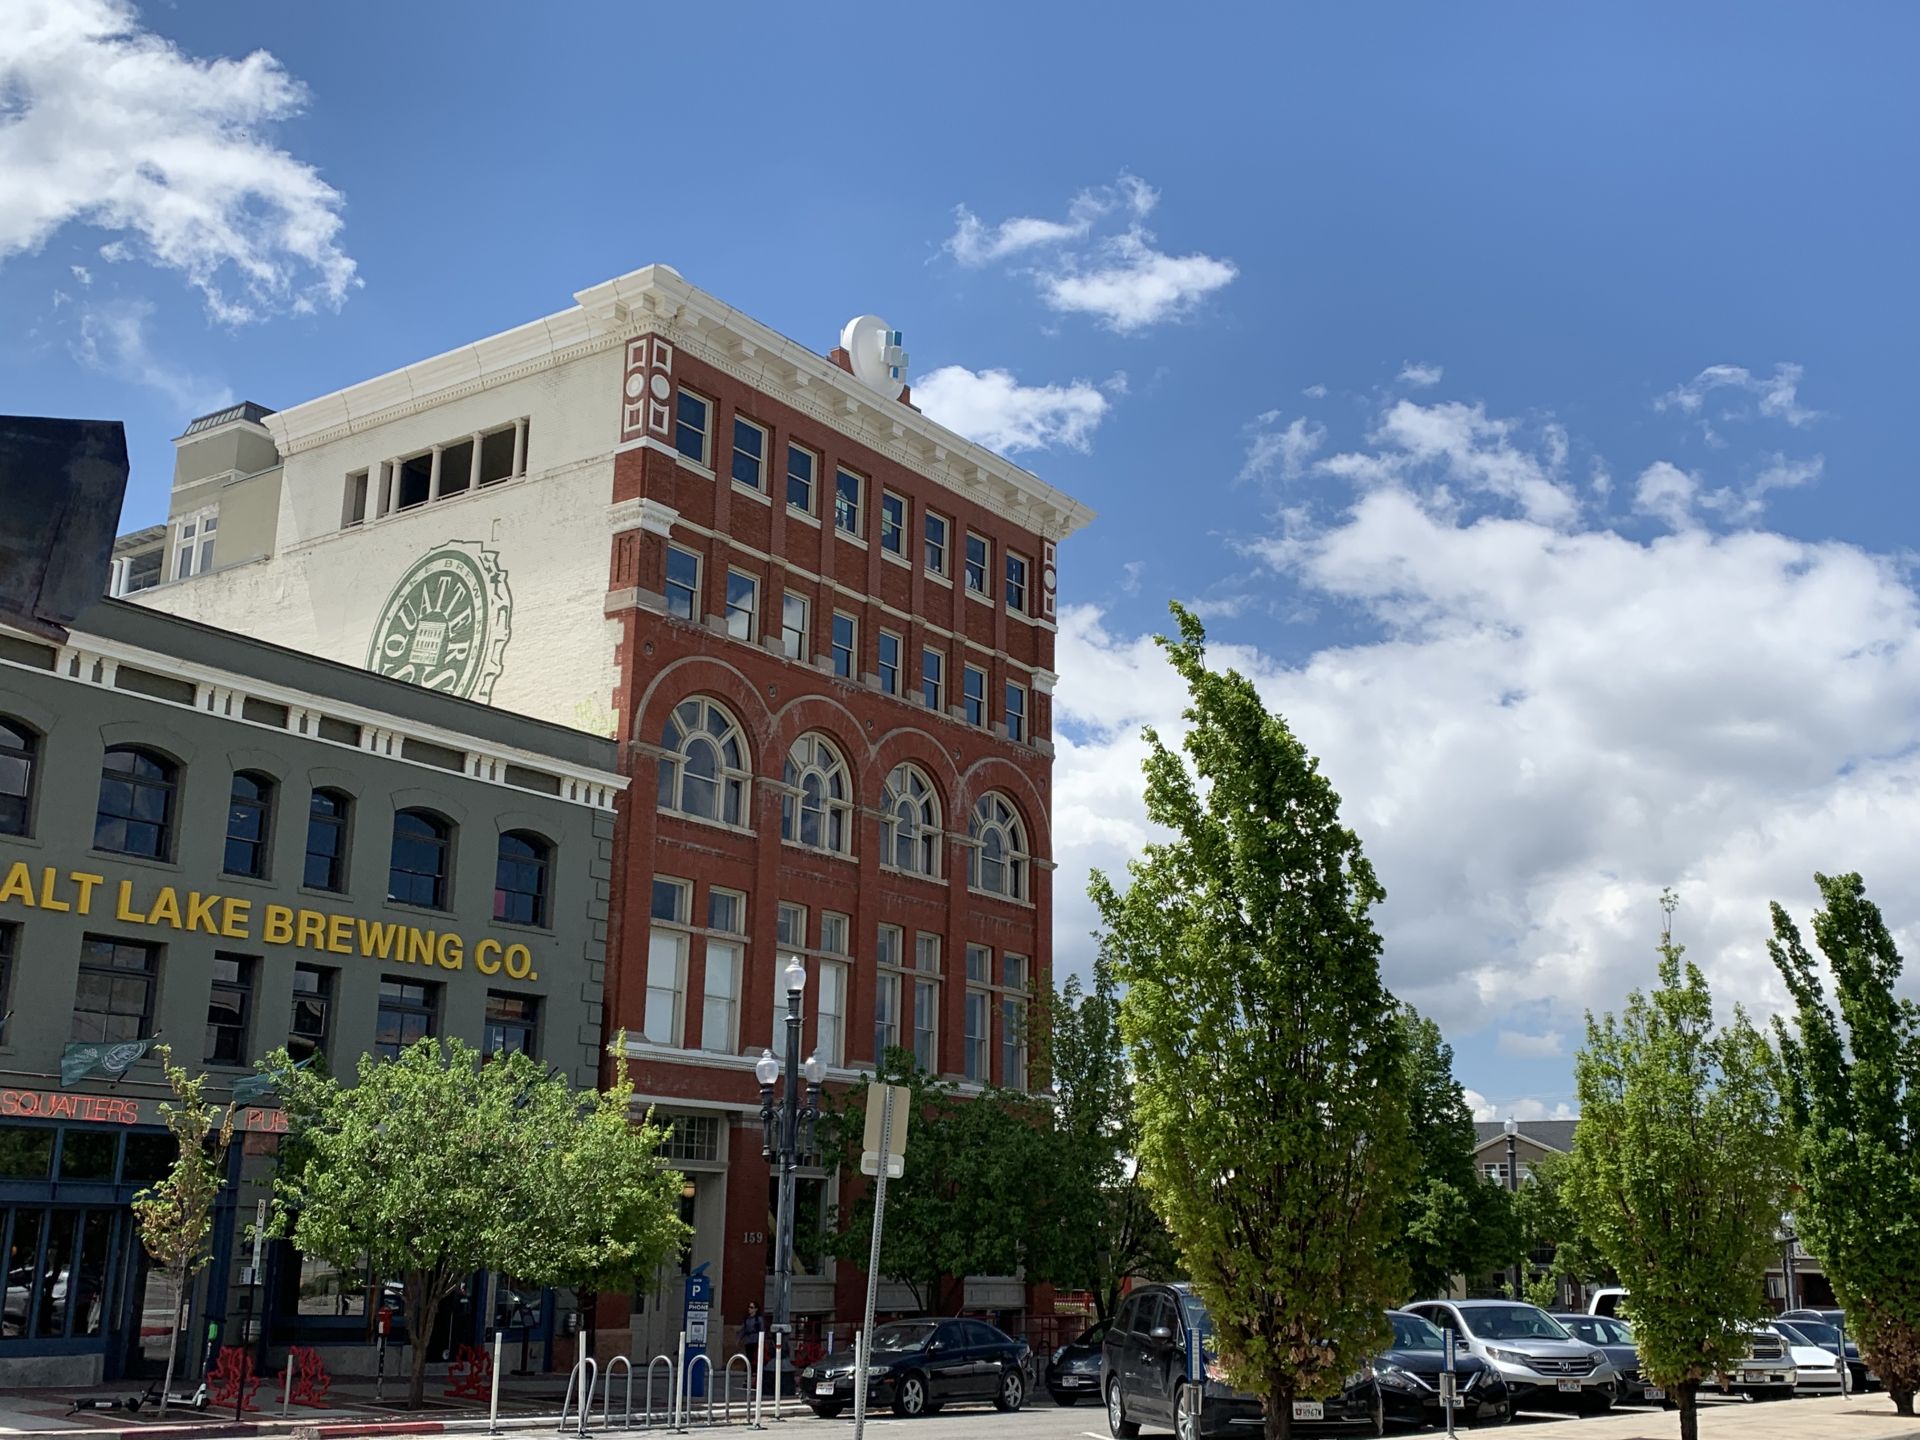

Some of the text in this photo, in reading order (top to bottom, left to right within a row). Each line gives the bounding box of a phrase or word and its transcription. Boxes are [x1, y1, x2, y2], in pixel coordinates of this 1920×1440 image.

[116, 880, 252, 938] LAKE
[263, 904, 464, 970] BREWING
[474, 938, 537, 980] CO.
[743, 1231, 763, 1243] 159
[692, 1285, 701, 1297] P
